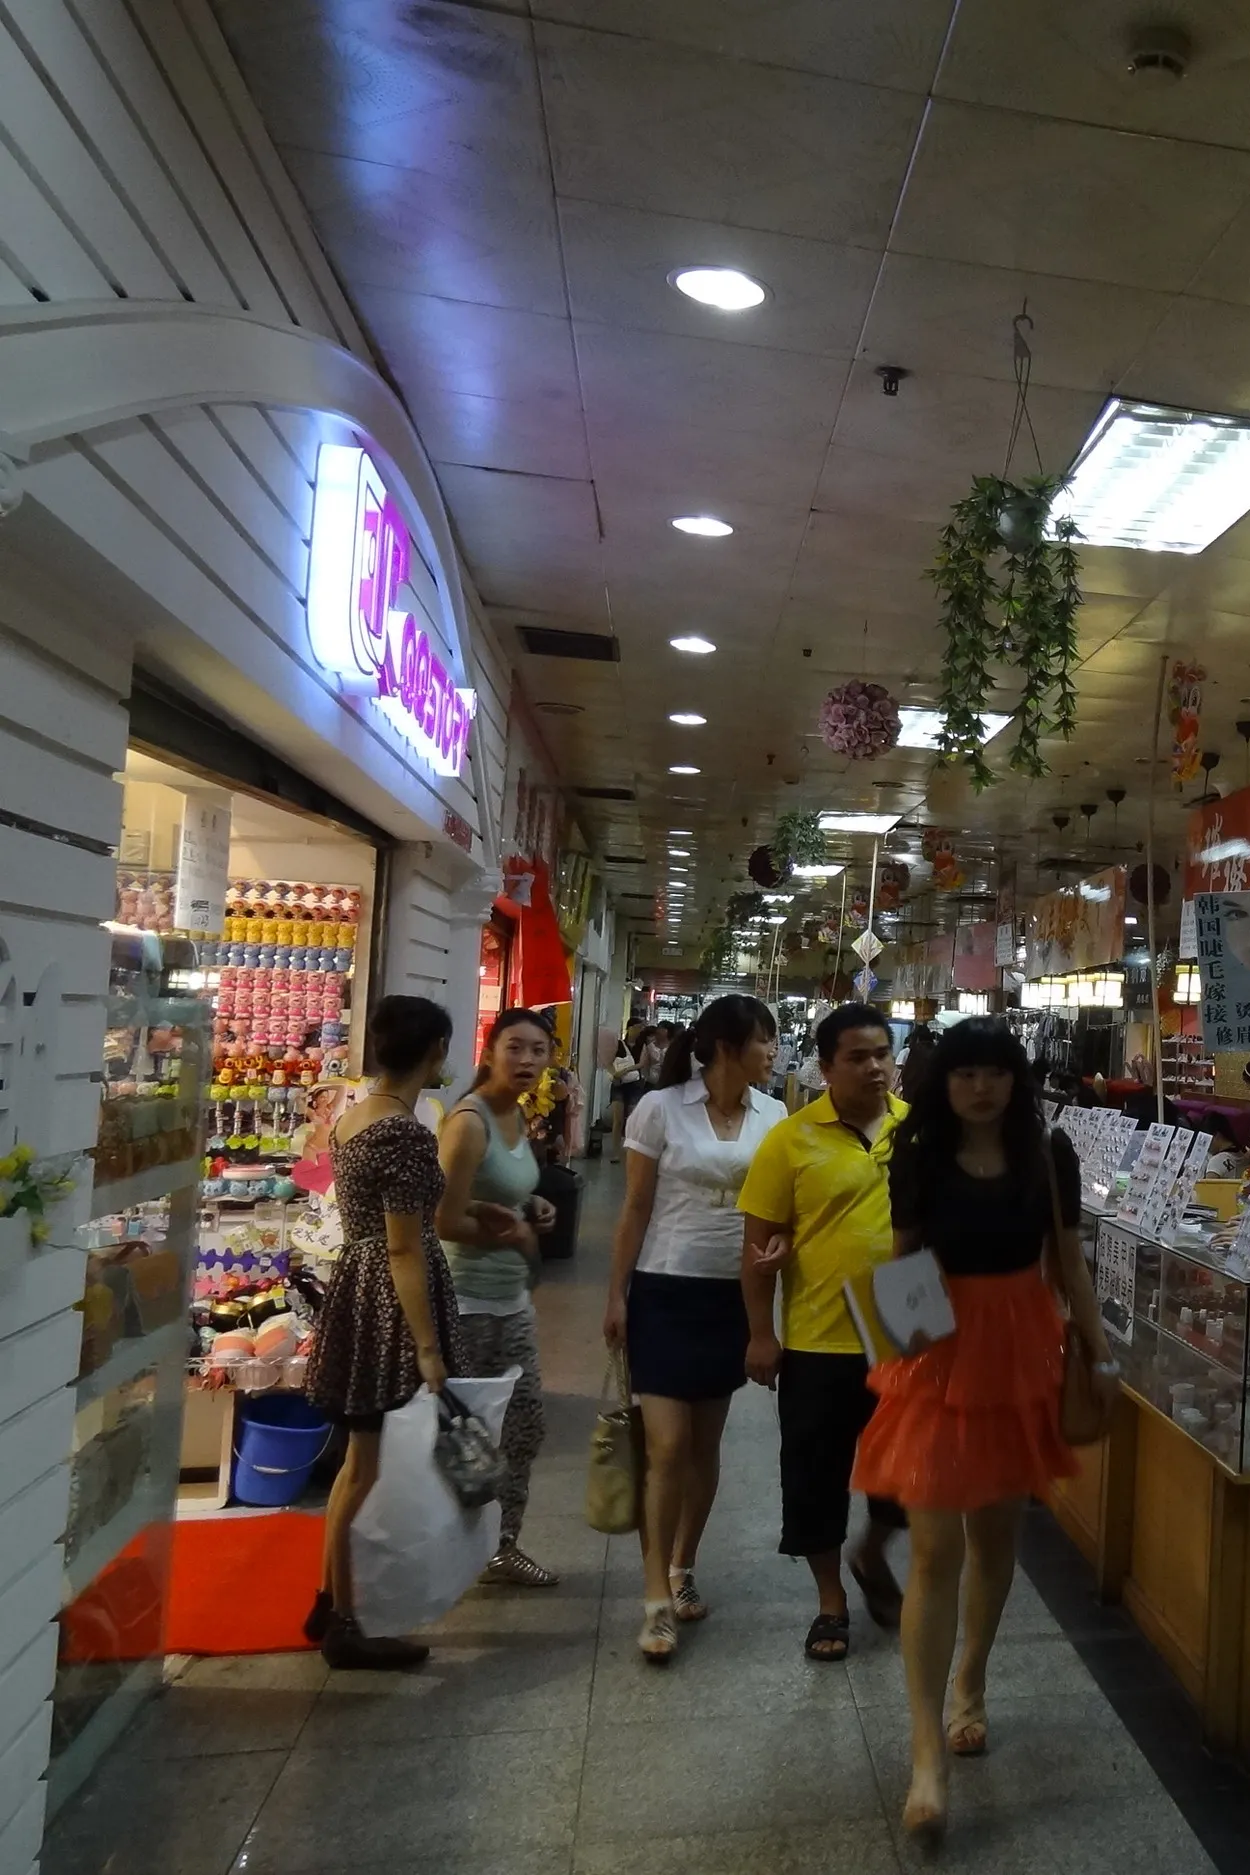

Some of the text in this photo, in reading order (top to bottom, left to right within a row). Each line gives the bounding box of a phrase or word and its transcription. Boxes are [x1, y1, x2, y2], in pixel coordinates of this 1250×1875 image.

[1197, 896, 1227, 1025] 韩国睫毛嫁接
